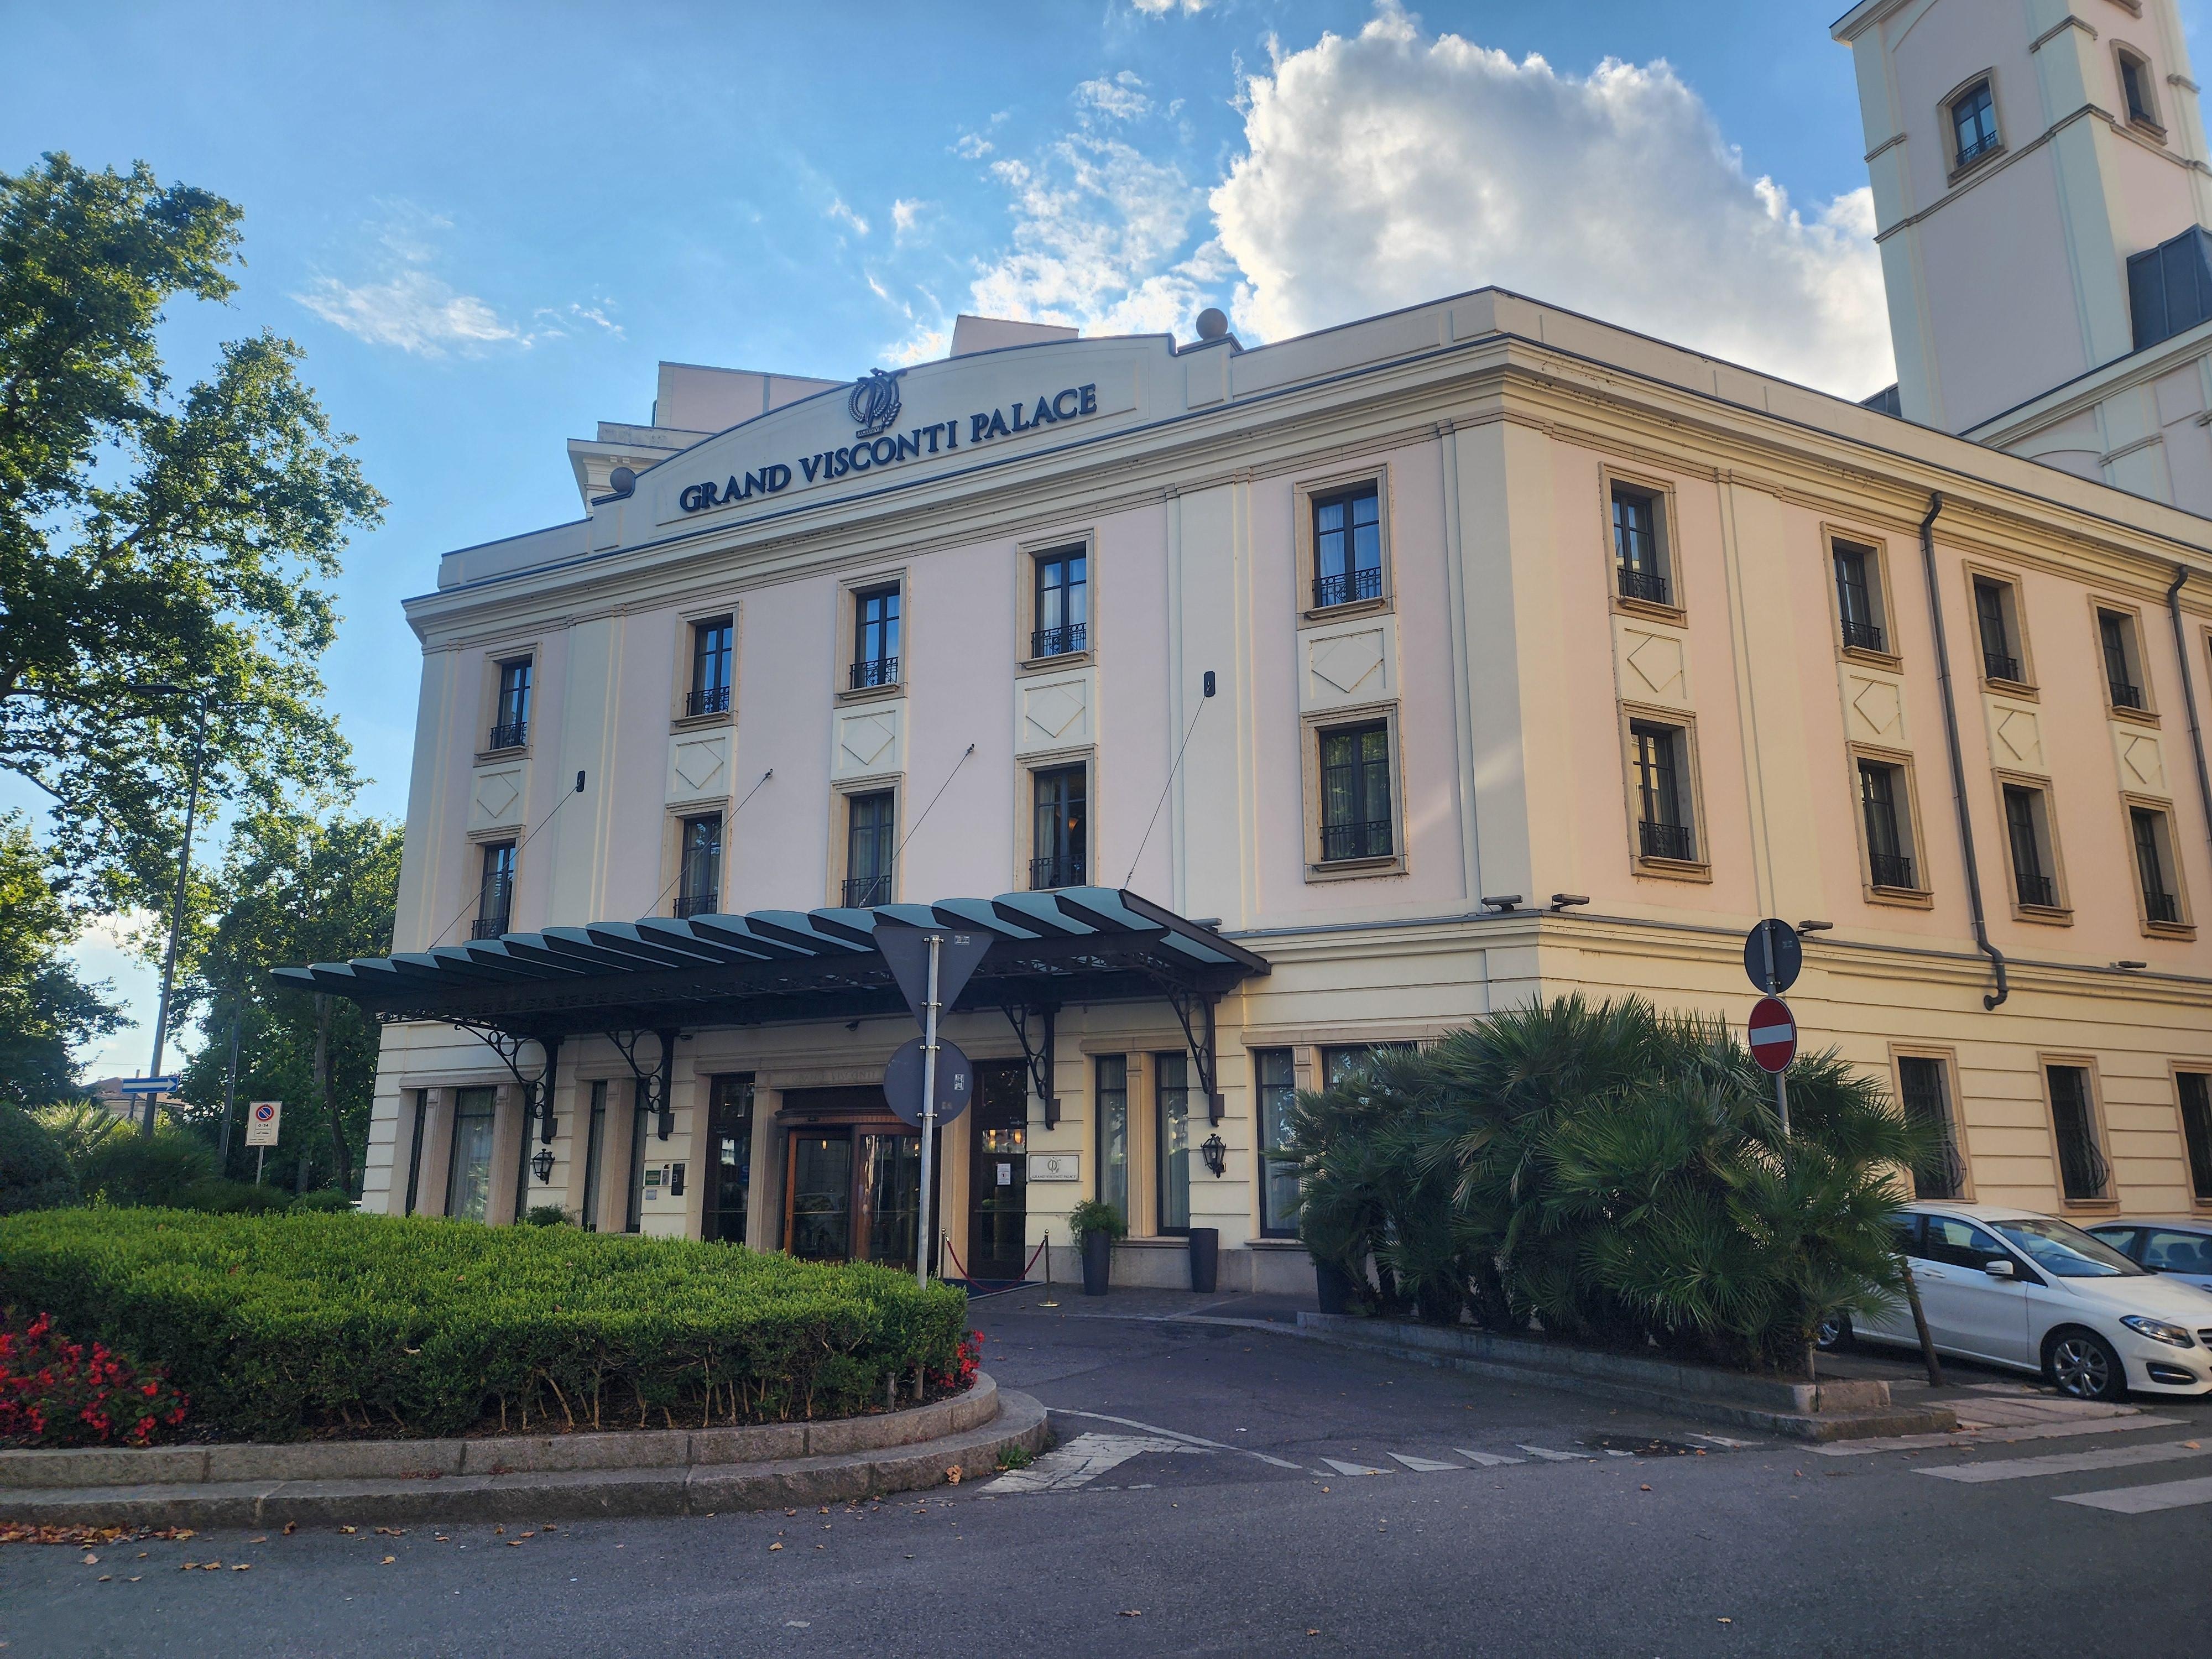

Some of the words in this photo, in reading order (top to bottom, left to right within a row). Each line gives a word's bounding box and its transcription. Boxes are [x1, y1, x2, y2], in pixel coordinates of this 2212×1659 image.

[680, 464, 791, 512] GRAND
[798, 420, 958, 483] VISCONTI
[970, 383, 1097, 442] PALACE
[857, 426, 882, 436] EXCLUSIVE
